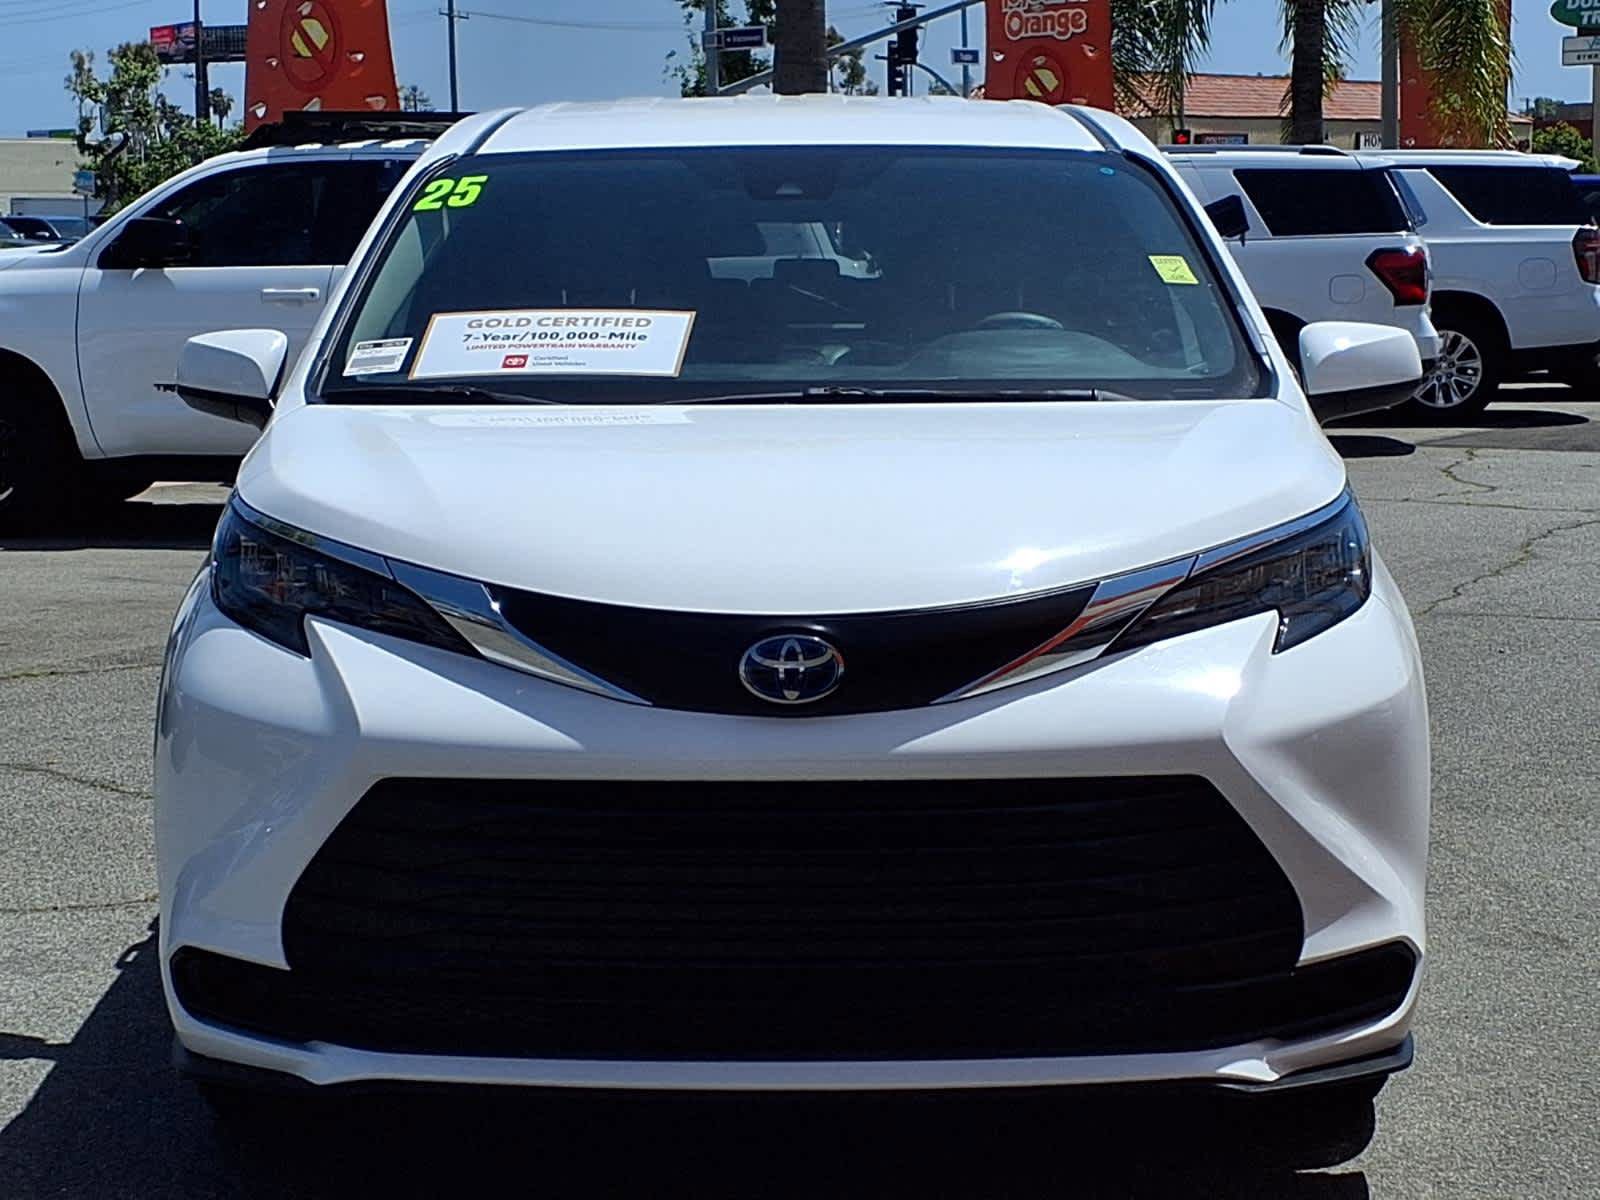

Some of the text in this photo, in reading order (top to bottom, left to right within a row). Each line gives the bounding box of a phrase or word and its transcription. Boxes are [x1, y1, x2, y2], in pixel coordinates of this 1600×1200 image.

[1004, 8, 1087, 40] Orange
[412, 174, 489, 212] 25
[467, 317, 652, 329] GOLD CERTIFIED
[462, 331, 647, 343] 7-Year/100,000-Mile
[466, 343, 506, 351] LIMITED
[507, 342, 576, 350] POWERTRAIN
